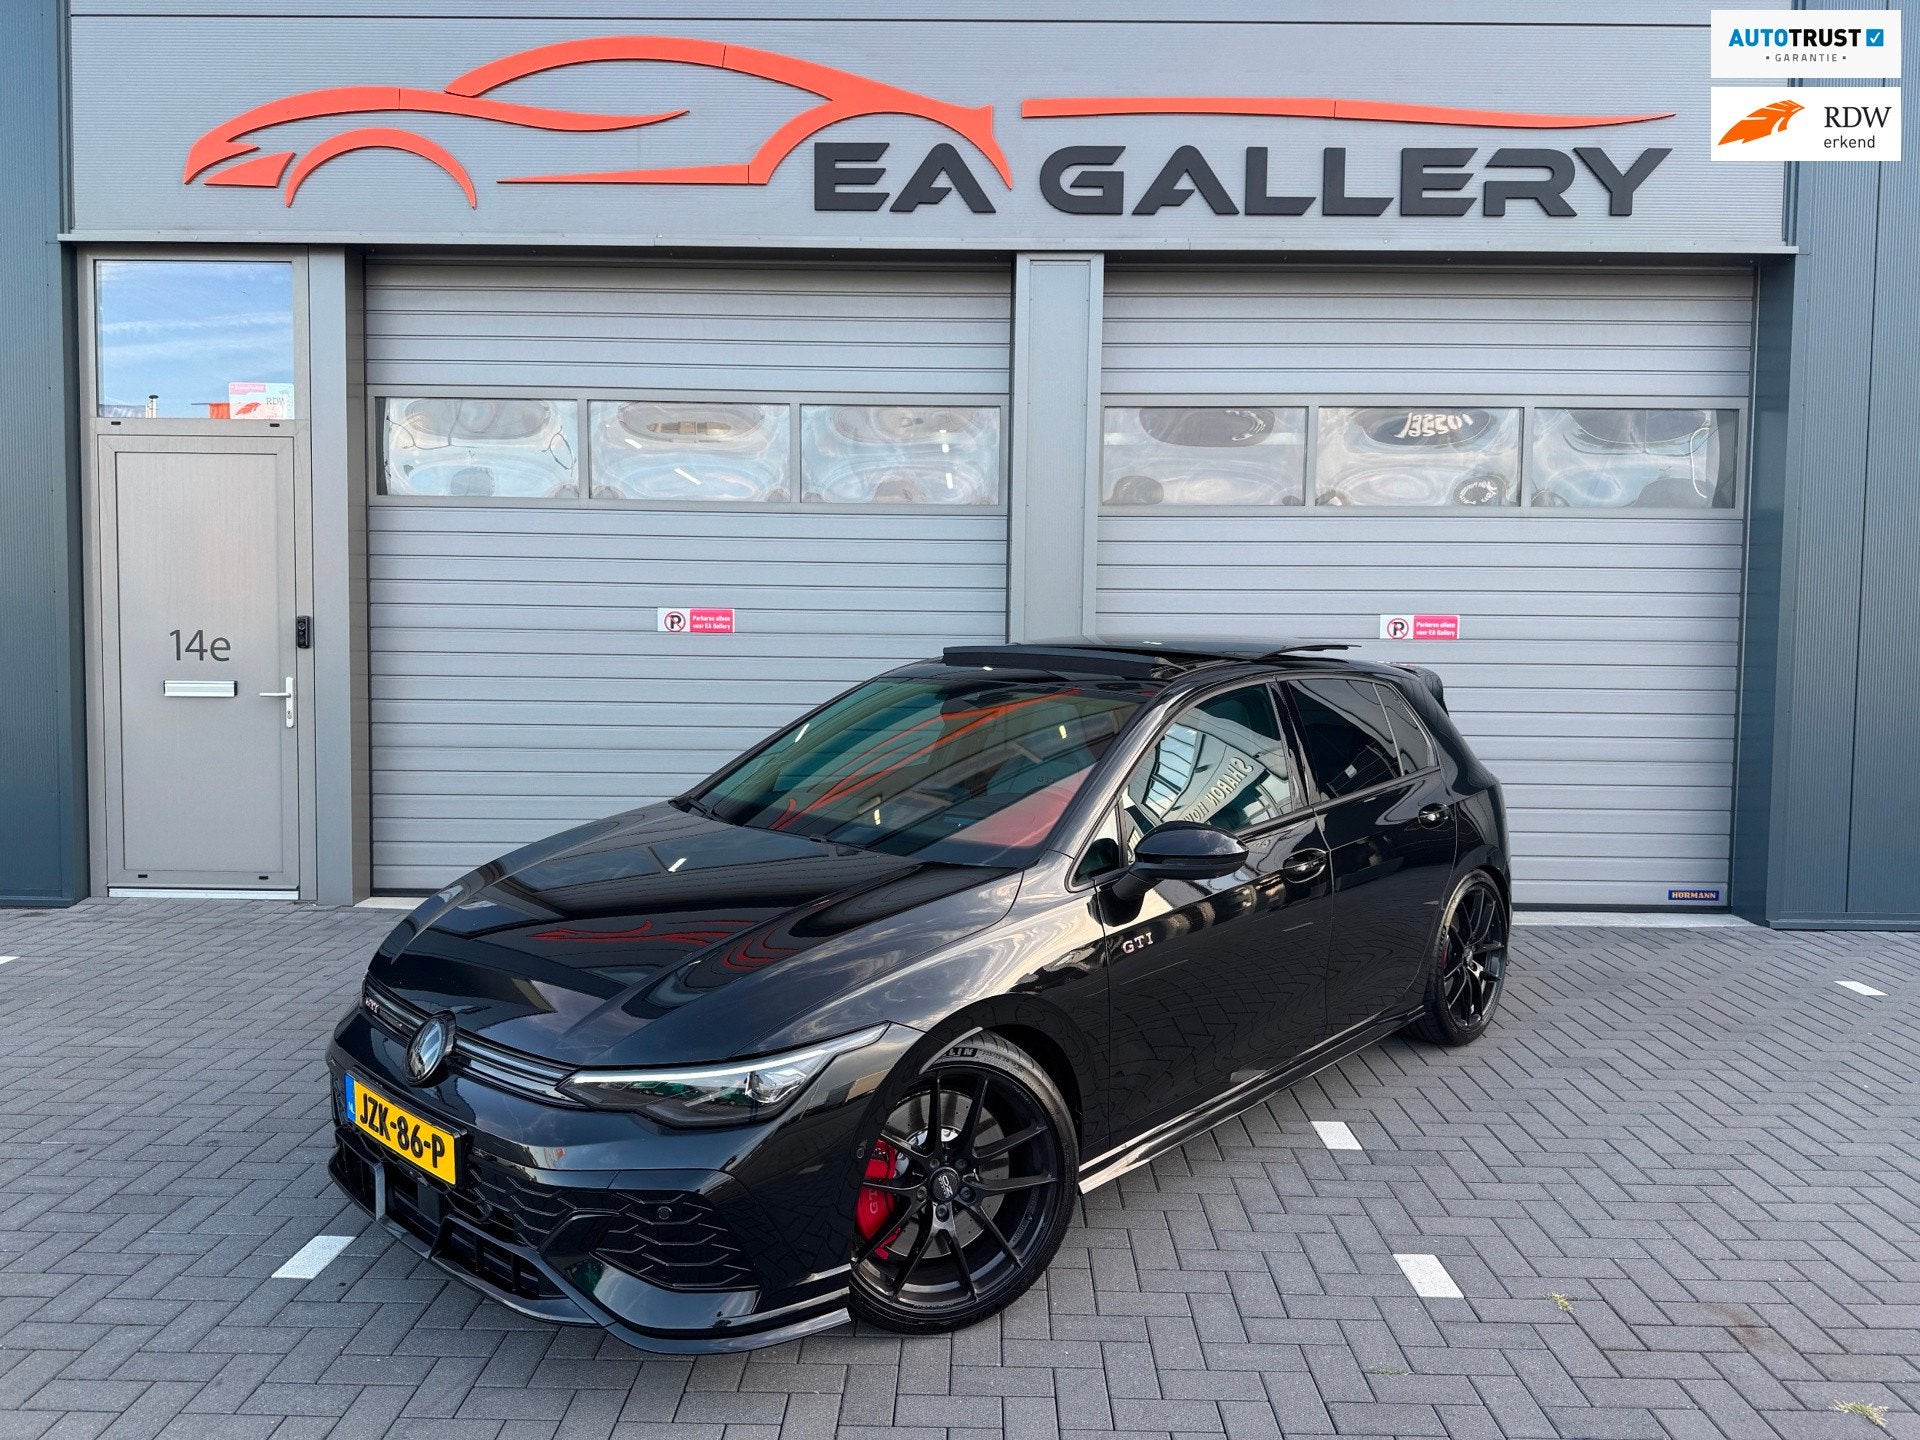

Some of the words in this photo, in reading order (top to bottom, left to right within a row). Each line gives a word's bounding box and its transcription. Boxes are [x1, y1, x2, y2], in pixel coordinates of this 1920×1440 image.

[814, 142, 997, 214] EA
[1039, 144, 1674, 217] GALLERY
[169, 629, 231, 662] 14e
[1122, 932, 1154, 954] GTI
[359, 1093, 445, 1169] JZK-86-P
